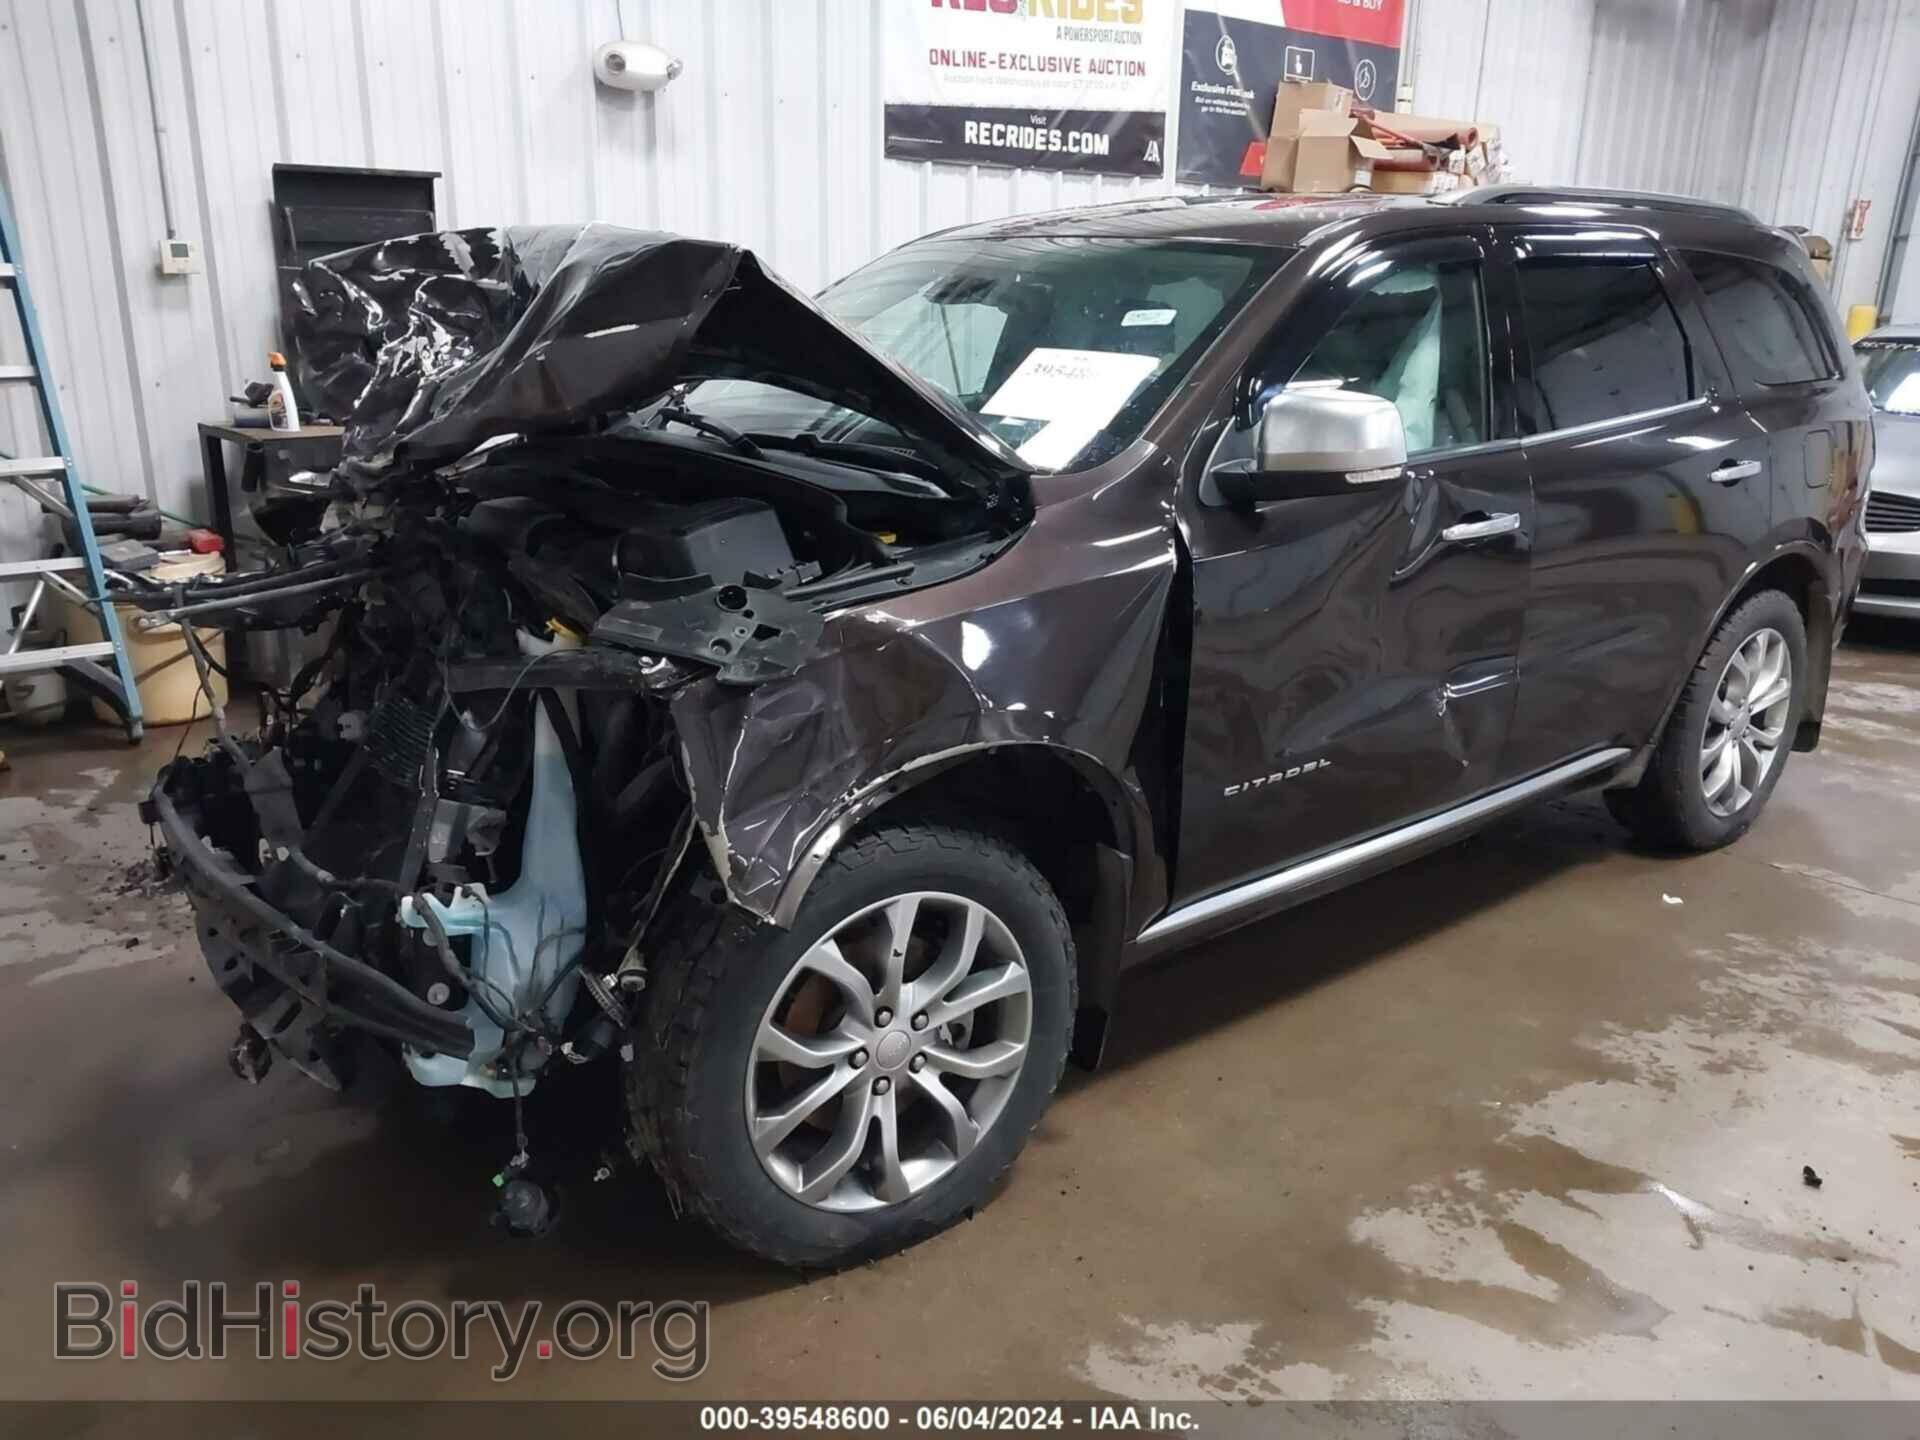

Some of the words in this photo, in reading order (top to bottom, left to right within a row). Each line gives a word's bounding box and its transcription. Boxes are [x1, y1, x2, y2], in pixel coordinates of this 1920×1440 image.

[1056, 25, 1062, 40] A
[1064, 26, 1113, 42] POWERSPORT
[1114, 29, 1142, 45] AUCTION
[929, 48, 1081, 74] ONLINE-EXCLUSIVE
[1088, 58, 1146, 76] AUCTION
[1030, 114, 1047, 125] Visit
[964, 120, 1110, 155] RECRIDES.COM
[1223, 758, 1332, 797] CITADEL
